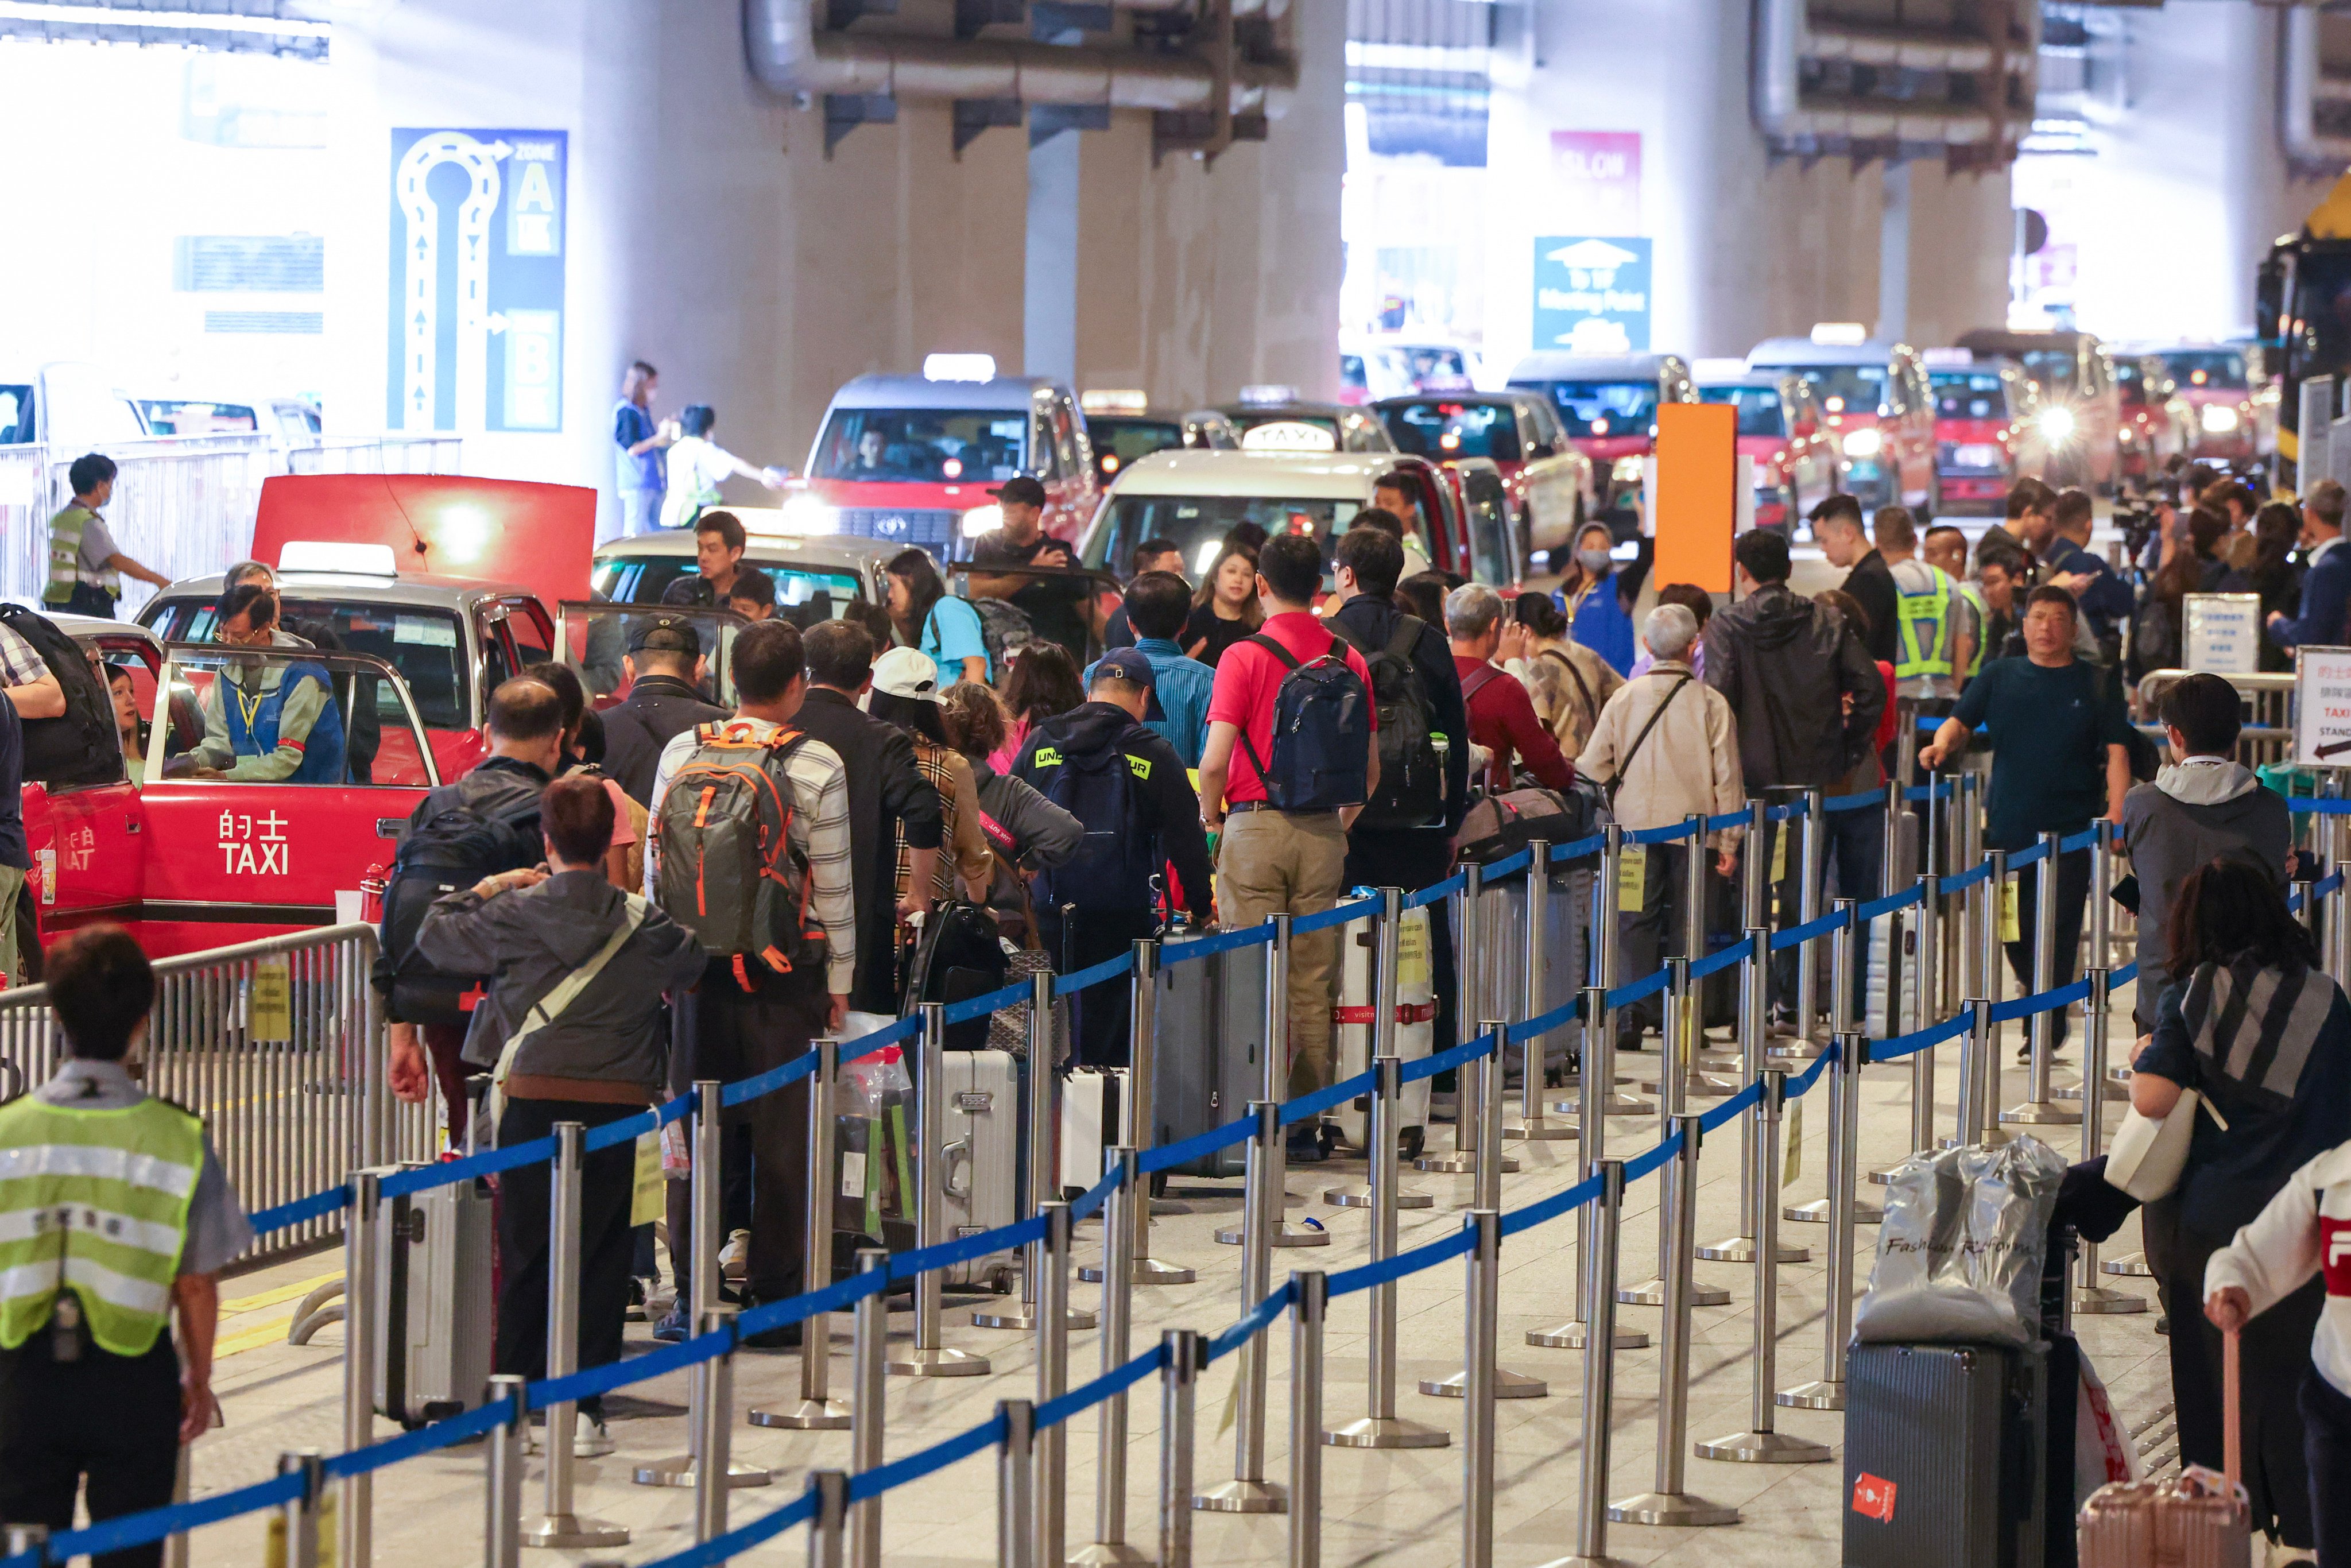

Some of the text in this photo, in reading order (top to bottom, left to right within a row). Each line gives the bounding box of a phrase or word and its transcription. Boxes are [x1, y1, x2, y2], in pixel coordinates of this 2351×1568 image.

[516, 162, 554, 212] A
[1259, 429, 1318, 442] TAXI
[219, 809, 288, 841] 的士
[218, 842, 288, 874] TAXI
